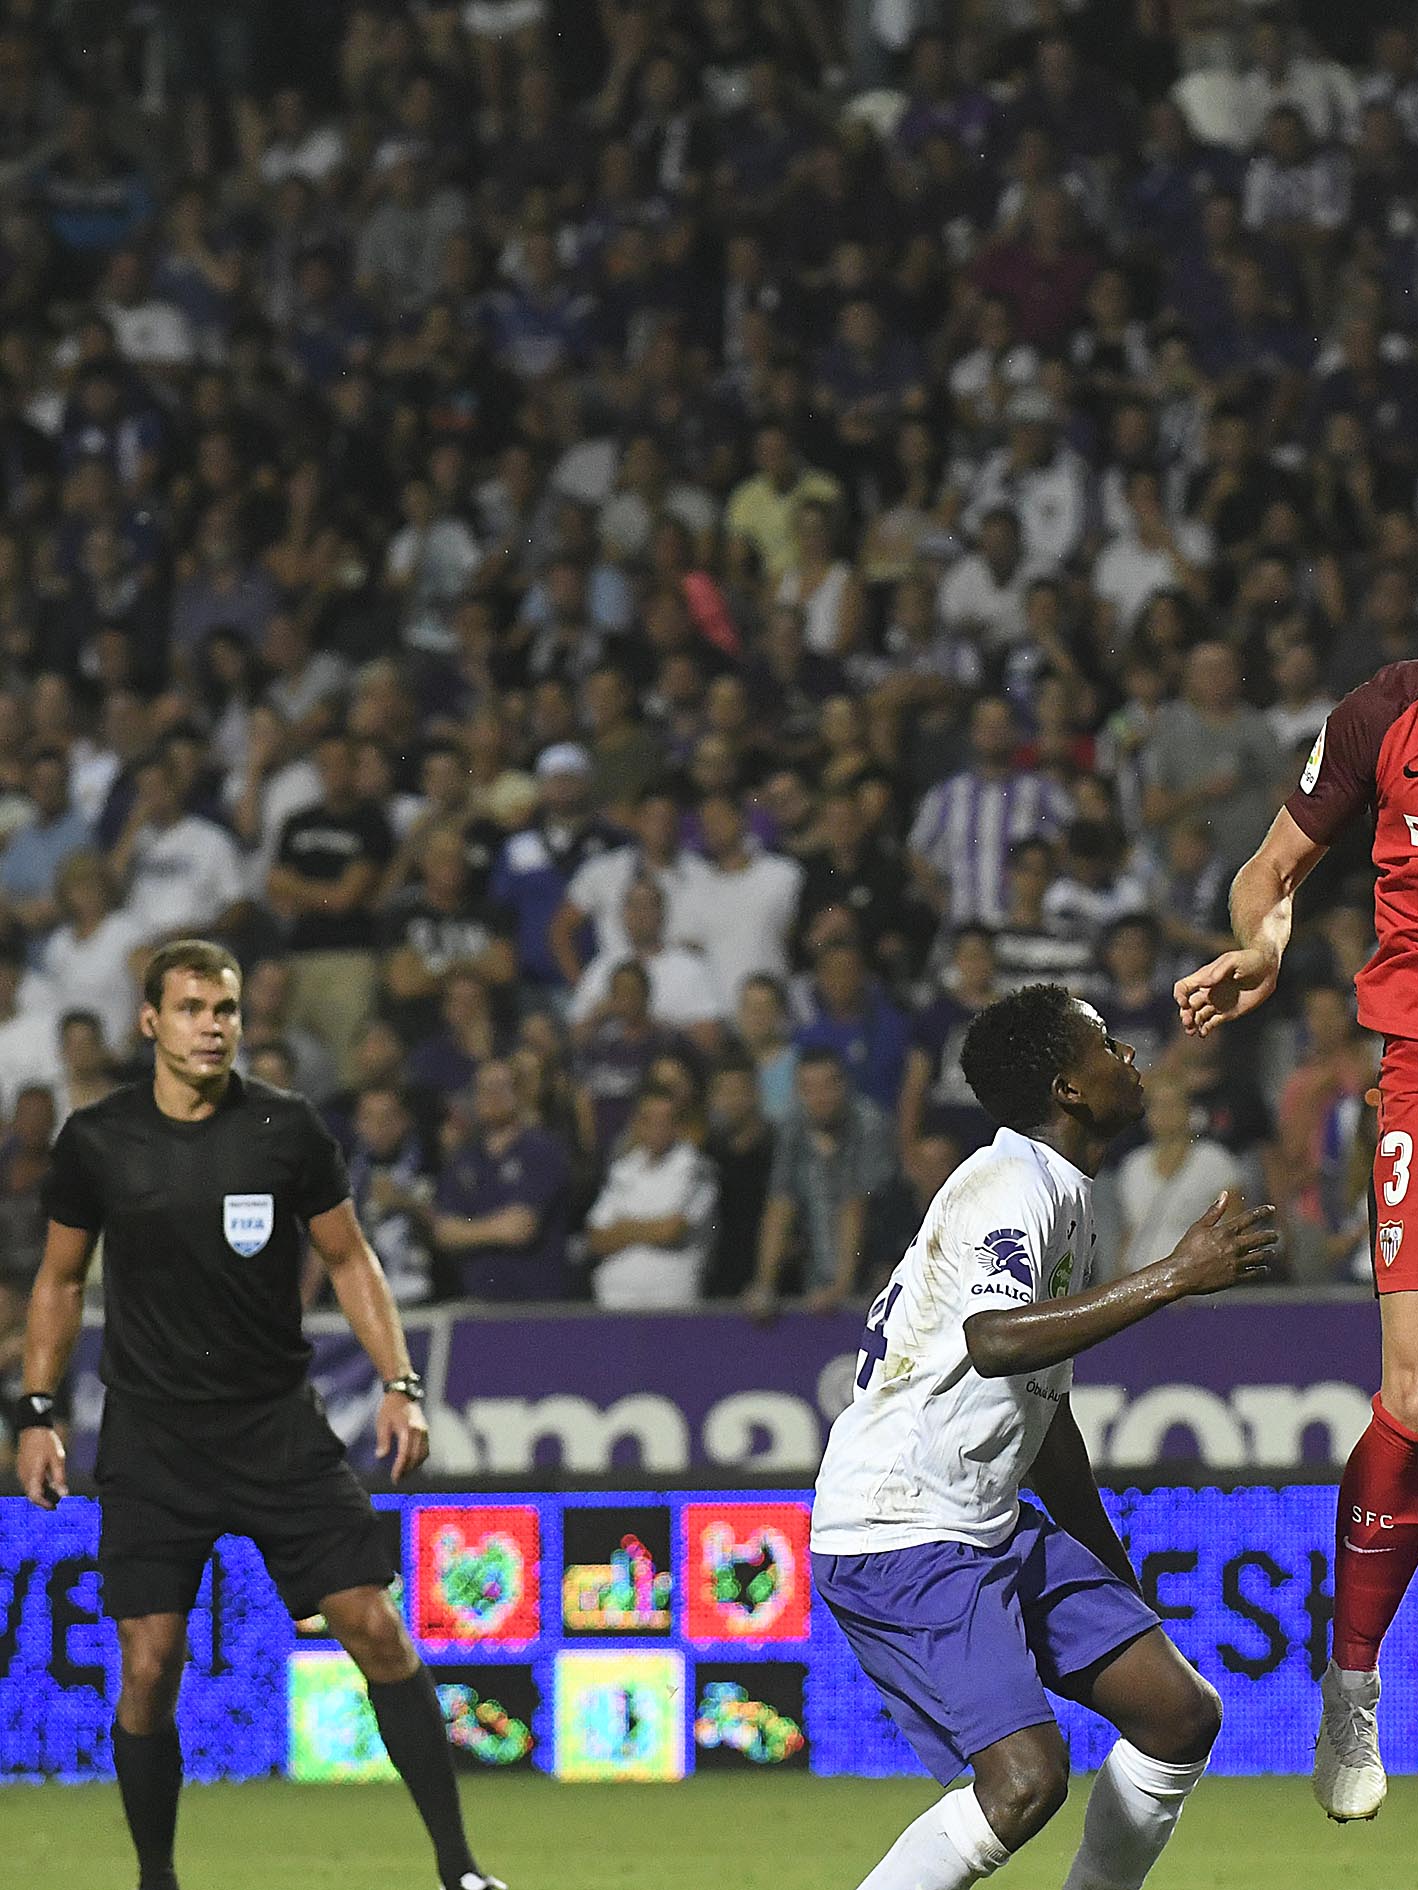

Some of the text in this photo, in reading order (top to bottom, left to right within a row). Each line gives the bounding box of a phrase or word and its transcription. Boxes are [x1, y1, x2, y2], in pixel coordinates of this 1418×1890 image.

[1381, 1131, 1413, 1206] 3
[231, 1218, 265, 1230] FIFA
[1352, 1505, 1394, 1529] SFC
